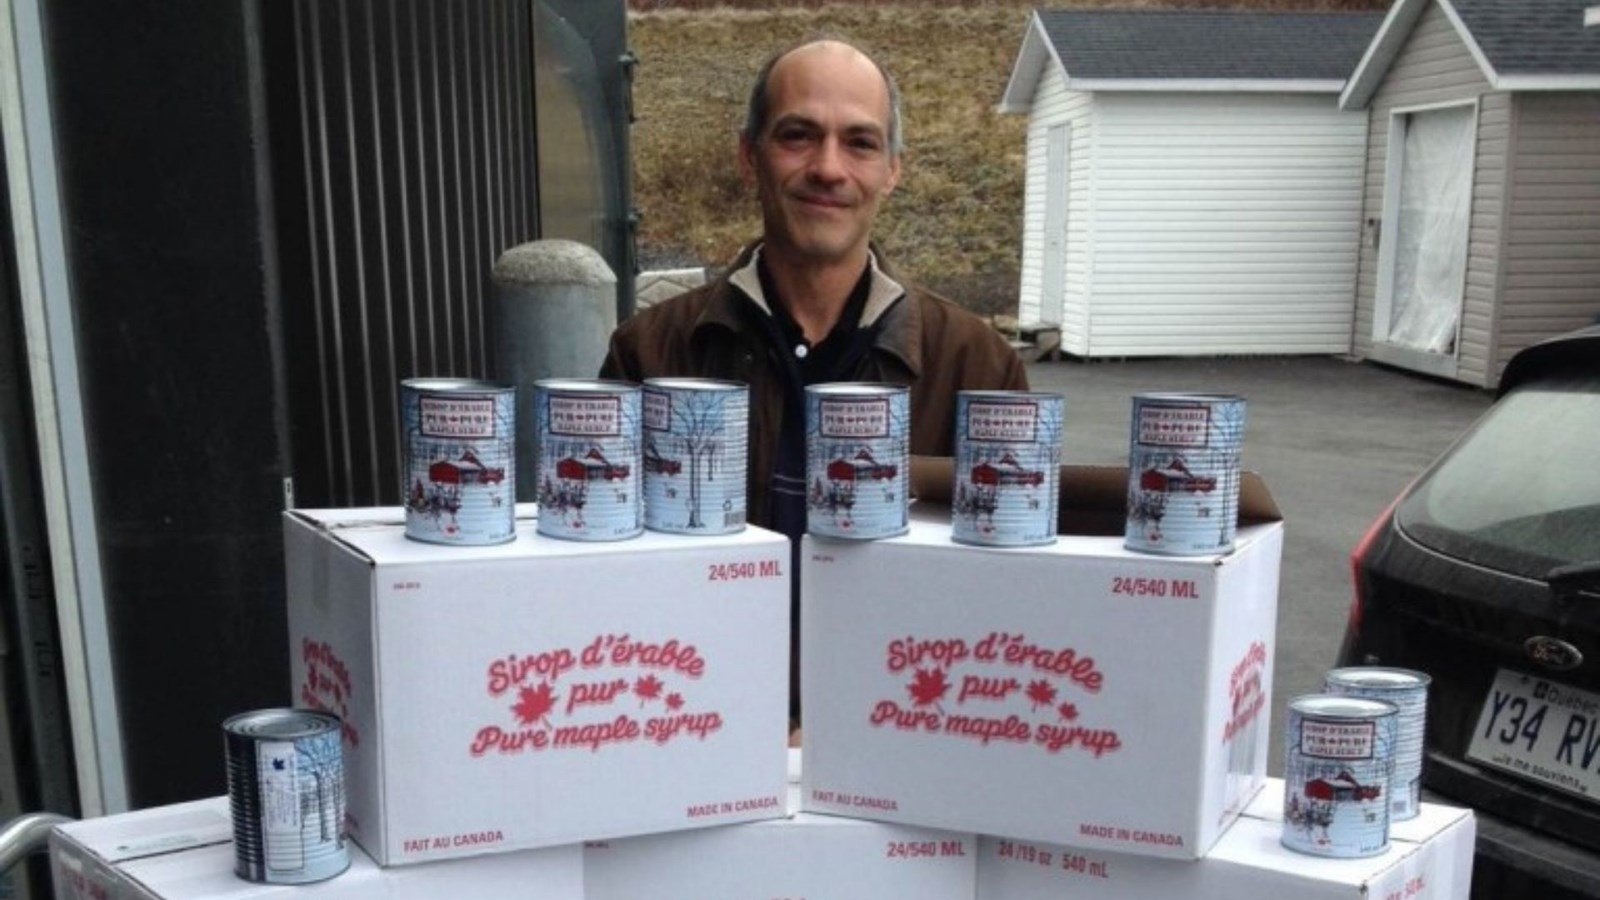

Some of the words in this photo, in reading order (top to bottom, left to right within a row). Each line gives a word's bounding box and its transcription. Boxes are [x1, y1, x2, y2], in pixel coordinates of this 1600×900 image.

[708, 562, 755, 582] 24/540
[759, 560, 783, 579] ML
[1112, 576, 1166, 597] 24/540
[1171, 580, 1199, 599] ML
[488, 648, 574, 694] Sirop
[580, 634, 706, 679] d'érable
[886, 636, 969, 672] Sirop
[974, 632, 1104, 693] d'érable
[565, 678, 629, 714] pur
[958, 674, 1019, 702] pur
[470, 723, 549, 757] Pure
[553, 714, 640, 752] maple
[643, 708, 722, 742] syrup
[870, 700, 941, 731] Pure
[945, 713, 1031, 744] maple
[1035, 723, 1122, 757] syrup
[1485, 690, 1549, 752] Y34
[1514, 757, 1530, 771] me
[1532, 763, 1580, 787] souviens
[687, 804, 719, 819] MADE
[721, 803, 732, 814] IN
[734, 797, 779, 813] CANADA
[812, 790, 835, 803] FAIT
[837, 792, 852, 804] AU
[853, 795, 898, 812] CANADA
[404, 839, 431, 854] FAIT
[433, 838, 451, 851] AU
[453, 831, 504, 847] CANADA
[886, 842, 937, 859] 24/540
[940, 839, 966, 857] ML
[1079, 823, 1115, 839] MADE
[1118, 828, 1130, 841] IN
[1132, 829, 1184, 848] CANADA
[1038, 851, 1053, 866] oz
[1061, 854, 1085, 874] 540
[1088, 859, 1109, 879] mL
